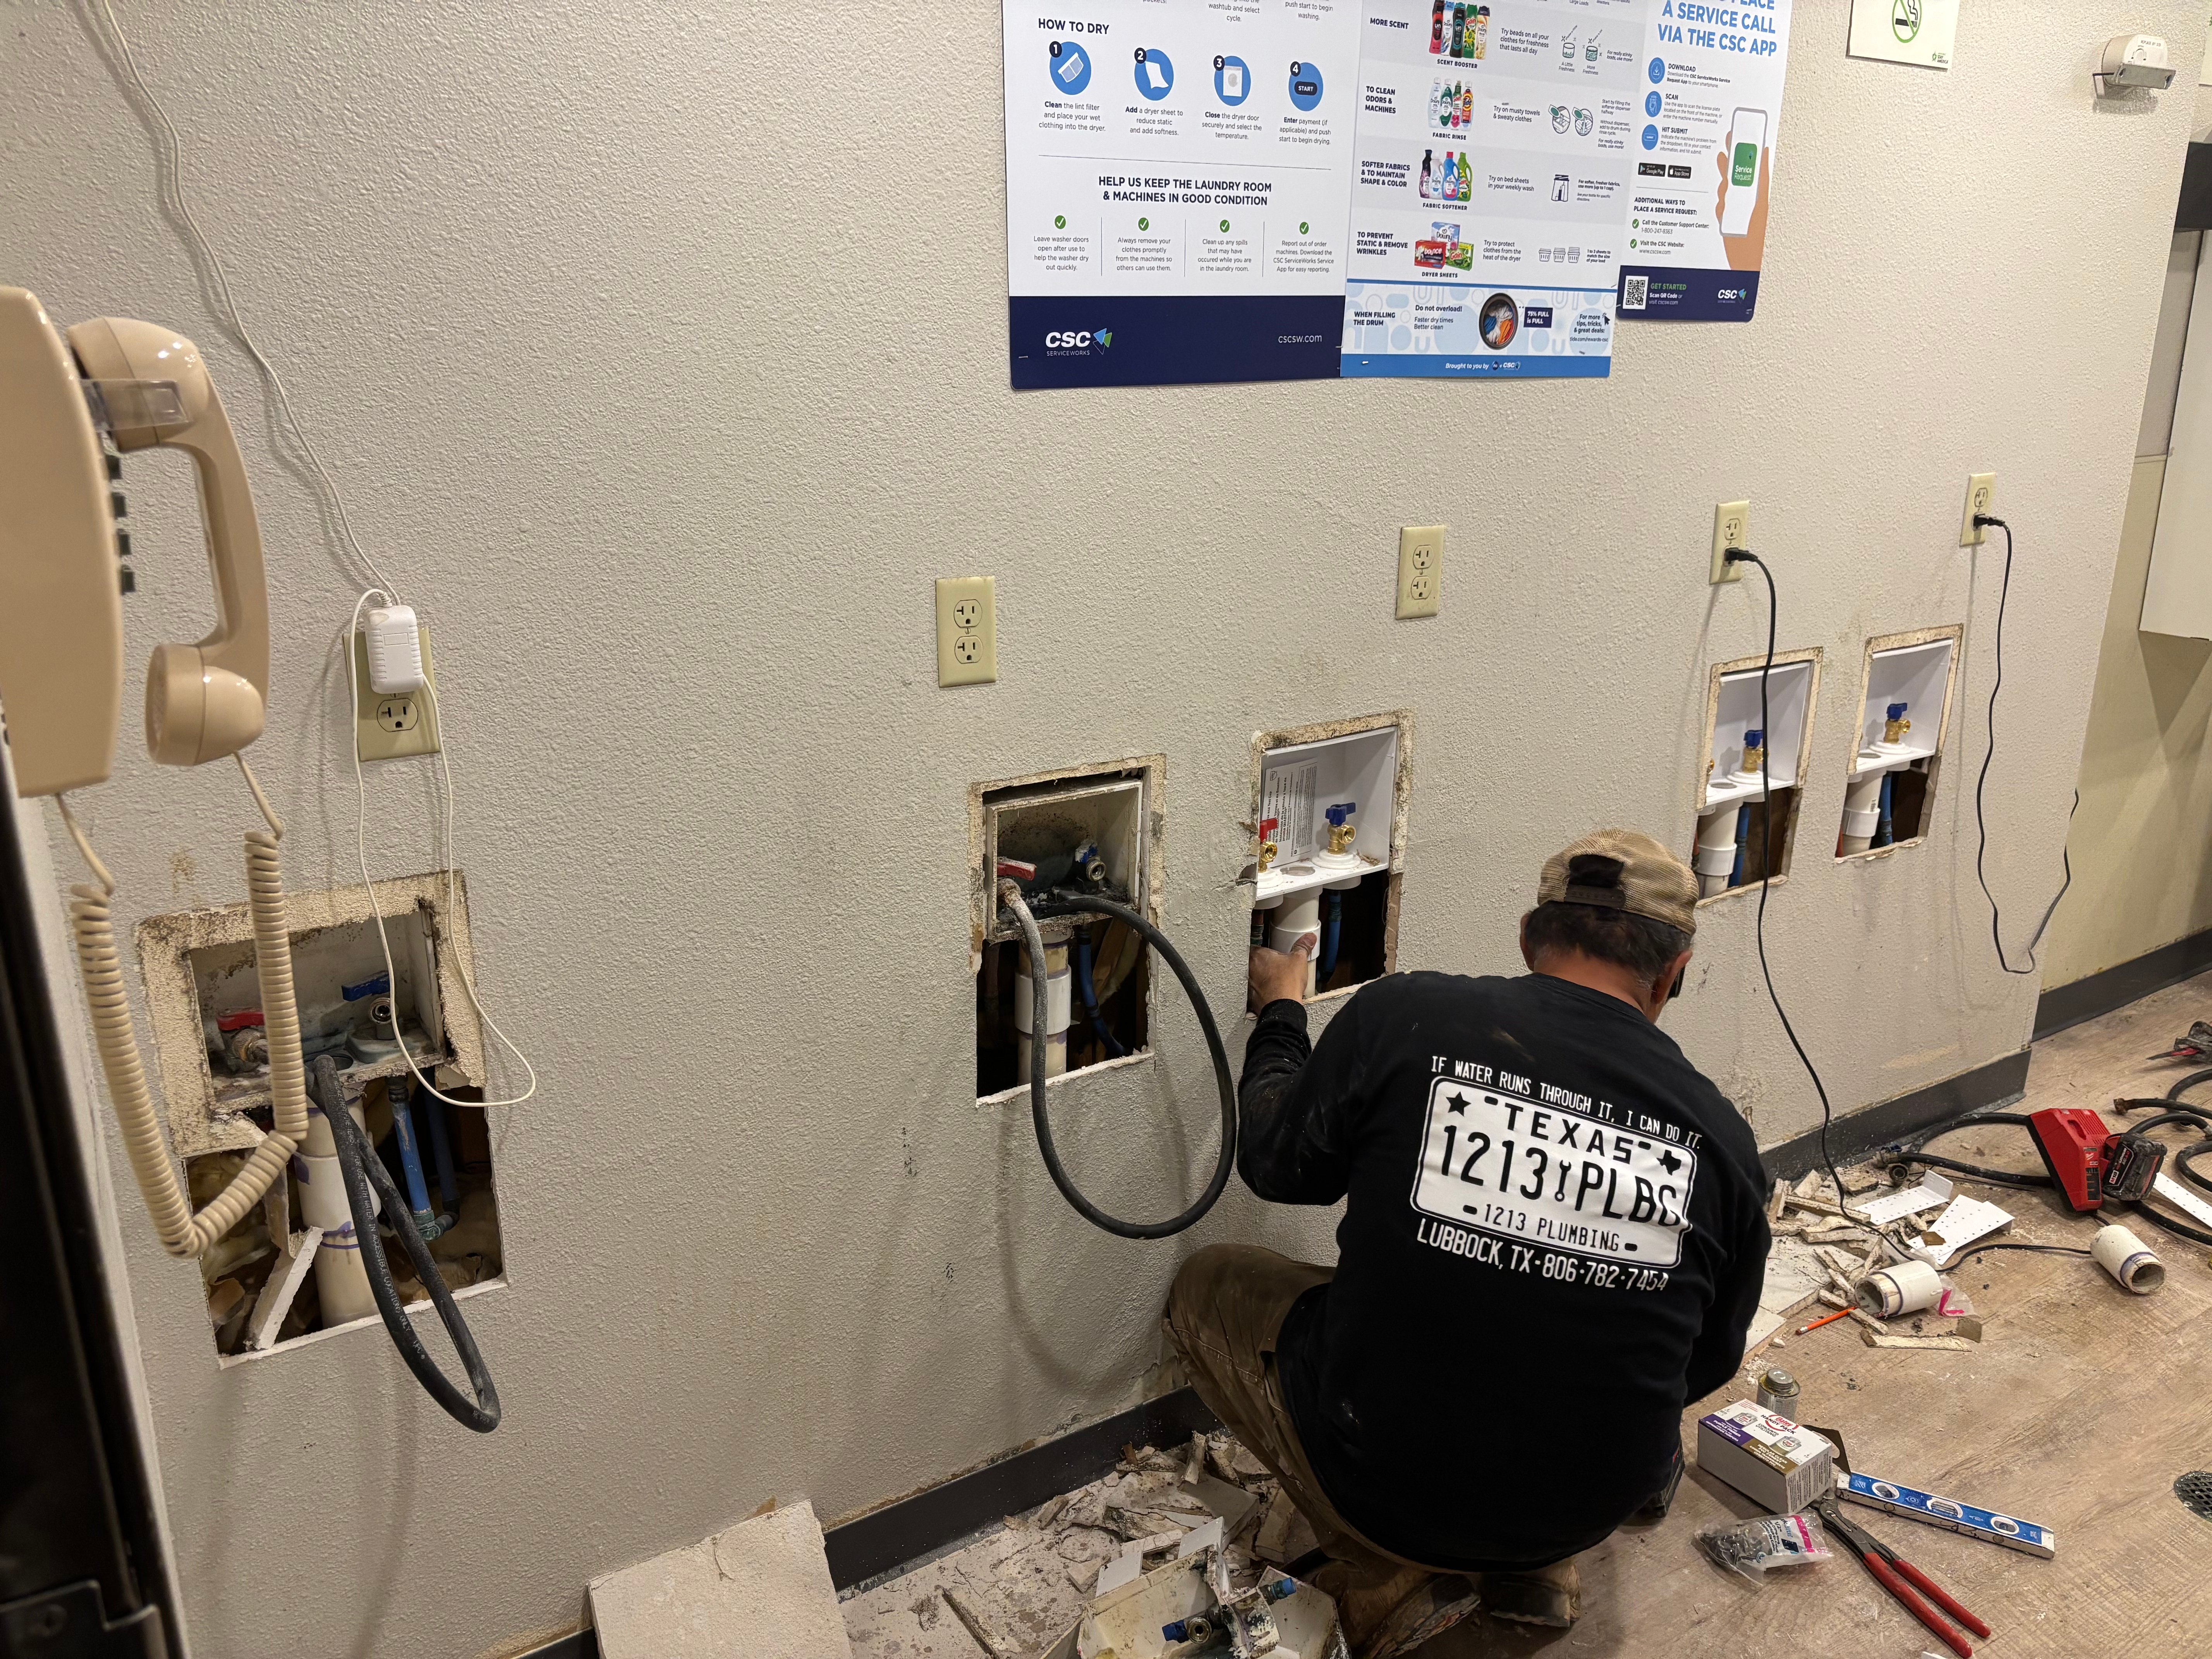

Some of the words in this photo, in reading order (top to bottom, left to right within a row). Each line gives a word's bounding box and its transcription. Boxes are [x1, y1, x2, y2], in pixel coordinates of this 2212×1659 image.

[1298, 13, 1320, 21] washing.
[1662, 0, 1673, 18] A
[1677, 2, 1738, 27] SERVICE
[1742, 14, 1776, 34] CALL
[1039, 18, 1066, 31] HOW
[1069, 21, 1084, 32] TO
[1088, 23, 1109, 34] DRY
[1370, 18, 1388, 26] MORE
[1389, 21, 1409, 29] SCENT
[1658, 24, 1683, 43] VIA
[1688, 28, 1716, 48] THE
[1719, 34, 1747, 53] CSC
[1749, 39, 1777, 57] APP
[1054, 45, 1057, 54] 1
[1138, 51, 1144, 60] 2
[1217, 58, 1222, 67] 3
[1668, 64, 1696, 72] DOWNLOAD
[1293, 64, 1298, 73] 4
[1376, 87, 1395, 95] CLEAN
[1366, 95, 1387, 103] ODORS
[1365, 105, 1396, 114] MACHINES
[1039, 122, 1063, 130] clothing
[1735, 165, 1752, 173] Service
[1376, 171, 1405, 179] MAINTAIN
[1099, 176, 1125, 186] HELP
[1128, 177, 1141, 187] US
[1145, 178, 1170, 188] KEEP
[1173, 179, 1192, 189] THE
[1195, 180, 1241, 191] LAUNDRY
[1244, 182, 1271, 192] ROOM
[1103, 191, 1109, 200] &
[1113, 191, 1166, 202] MACHINES
[1169, 193, 1179, 203] IN
[1182, 194, 1211, 203] GOOD
[1214, 195, 1267, 206] CONDITION
[1450, 252, 1462, 260] Gain
[1718, 290, 1737, 299] CSC
[1046, 332, 1091, 348] CSC
[1432, 1056, 1447, 1073] IF
[1455, 1060, 1492, 1084] WATER
[1499, 1071, 1531, 1095] RUNS
[1540, 1083, 1592, 1113] THROUGH
[1598, 1102, 1614, 1123] IT,
[1626, 1110, 1633, 1126] I
[1640, 1115, 1660, 1135] CAN
[1666, 1124, 1680, 1141] DO
[1685, 1132, 1702, 1149] IT.
[1505, 1103, 1633, 1164] TEXAS
[357, 1169, 365, 1180] USE
[1441, 1125, 1548, 1200] 1213
[1575, 1161, 1680, 1227] PLBG
[360, 1182, 368, 1198] WITH
[364, 1200, 373, 1220] WATER
[1485, 1204, 1526, 1231] 1213
[1537, 1218, 1619, 1252] PLUMBING
[1417, 1218, 1503, 1269] LUBBOCK,
[372, 1234, 388, 1274] ACCESSIBLE
[384, 1277, 403, 1313] LOCATIONS
[400, 1316, 411, 1331] ONLY
[1781, 1424, 1796, 1434] PACK
